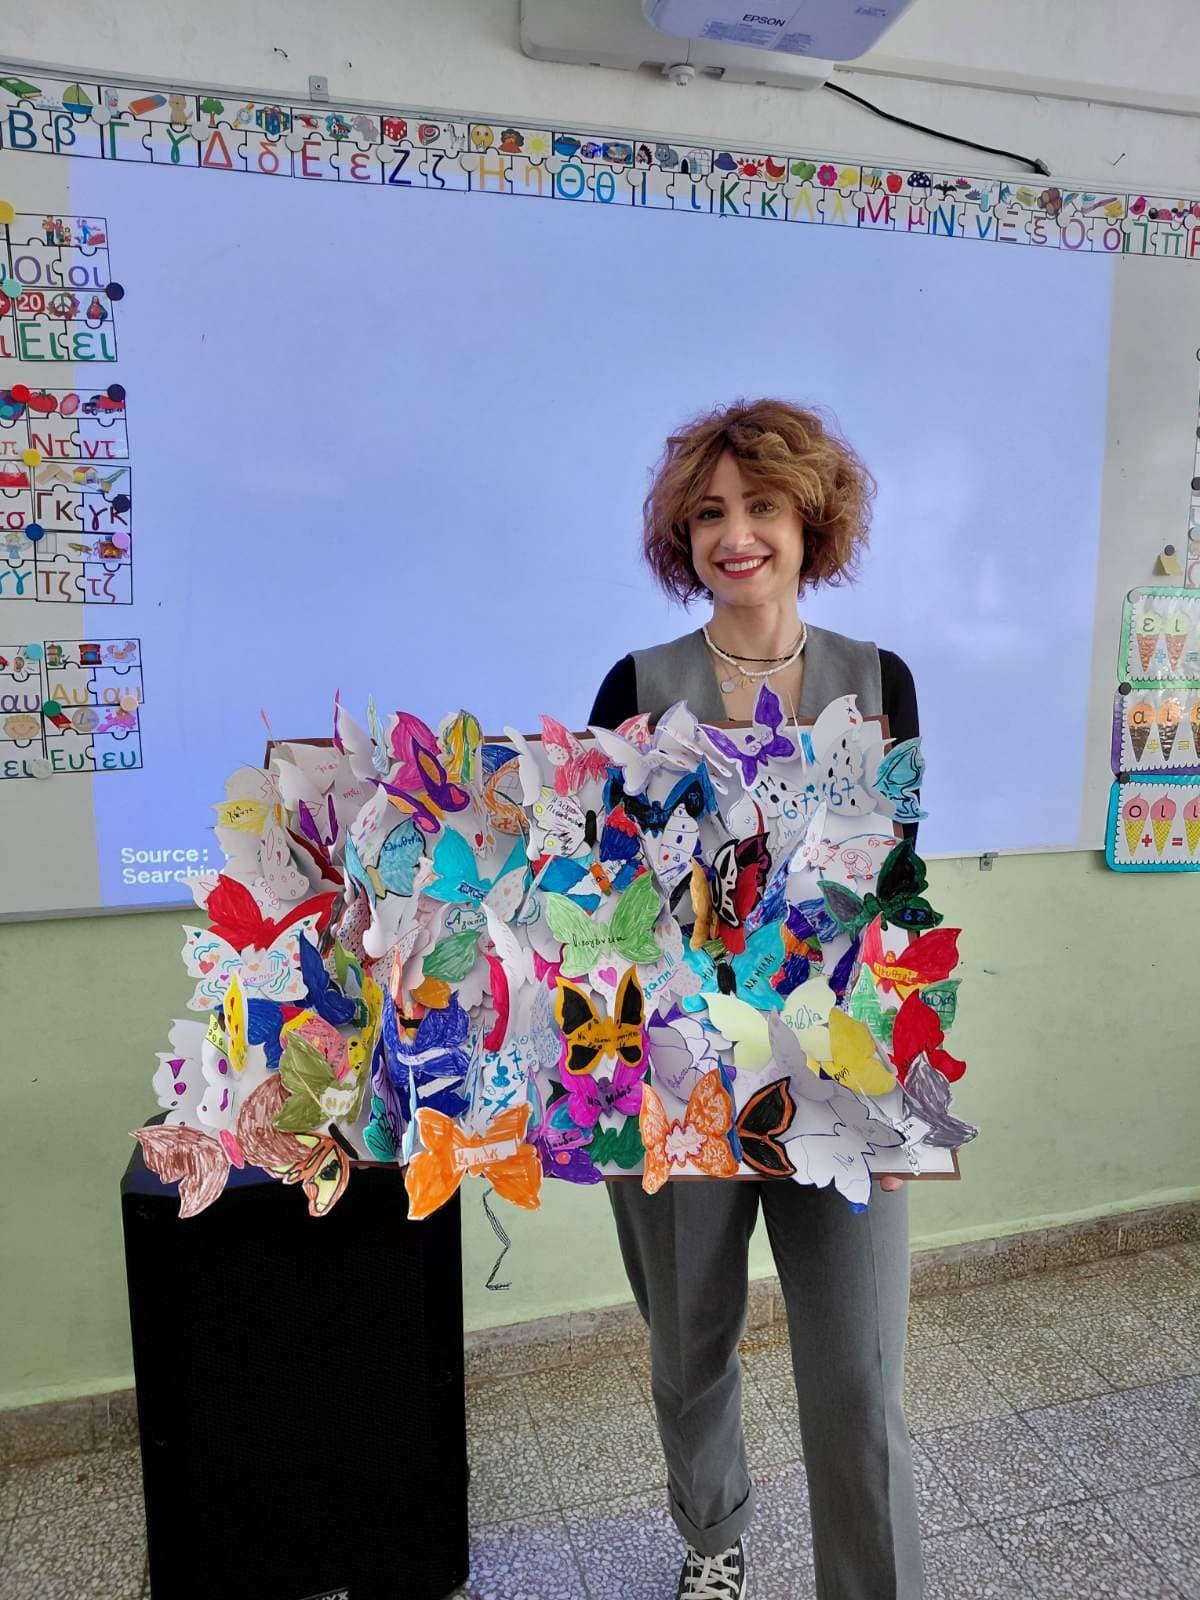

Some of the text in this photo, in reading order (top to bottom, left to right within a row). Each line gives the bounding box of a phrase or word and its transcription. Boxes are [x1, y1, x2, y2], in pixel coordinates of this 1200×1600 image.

[742, 13, 786, 27] EPSON
[55, 114, 76, 152] β
[109, 121, 130, 160] Γ
[166, 129, 191, 163] γ
[203, 130, 232, 168] Δ
[257, 141, 279, 174] δ
[350, 153, 371, 181] ε
[431, 154, 446, 188] ζ
[525, 165, 543, 194] η
[556, 163, 585, 198] Θ
[596, 171, 615, 204] θ
[1000, 210, 1018, 241] Ξ
[1031, 216, 1048, 244] ξ
[1161, 232, 1184, 255] π
[15, 256, 57, 285] Οι
[68, 266, 104, 287] οι
[18, 294, 41, 311] 20
[20, 323, 115, 360] Ει ει
[32, 433, 115, 458] Ντ ντ
[37, 493, 73, 521] Γκ
[39, 571, 115, 602] Τζ τζ
[1, 694, 40, 712] αυ
[52, 683, 89, 705] Αυ
[51, 749, 136, 771] Ευ ευ
[121, 847, 208, 864] Source:
